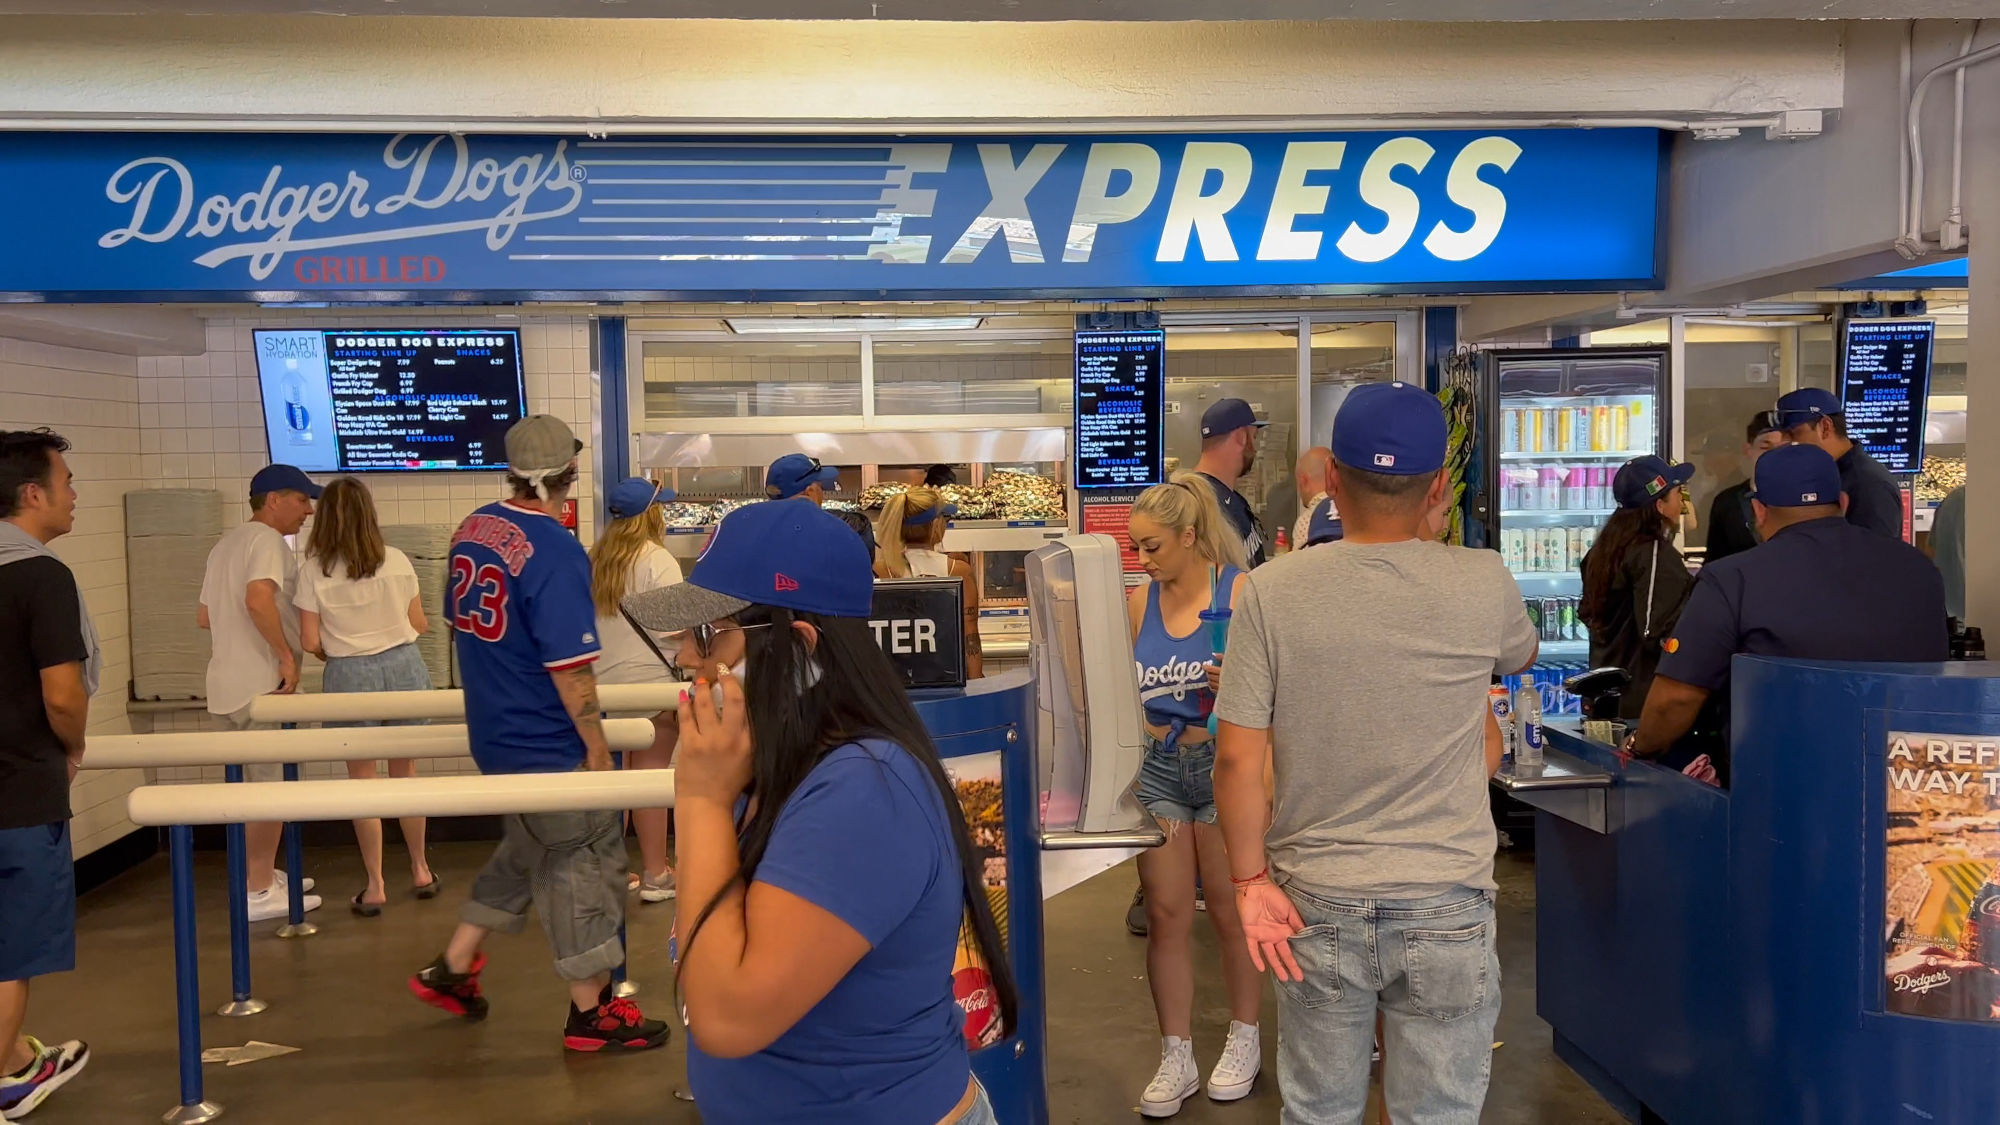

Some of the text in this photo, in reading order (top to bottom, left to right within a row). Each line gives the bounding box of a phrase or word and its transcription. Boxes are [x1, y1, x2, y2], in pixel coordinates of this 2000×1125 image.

[98, 156, 370, 280] Dodger
[375, 134, 582, 251] Dogs
[866, 136, 1523, 264] EXPRESS
[293, 256, 447, 283] GRILLED
[265, 337, 316, 350] SMART
[336, 337, 504, 347] DODGER DOG EXPRESS
[451, 554, 509, 642] 23
[1531, 708, 1541, 744] smart
[1888, 738, 2000, 765] A REF
[1888, 767, 1971, 794] WAY
[1894, 970, 1951, 994] Dodgers
